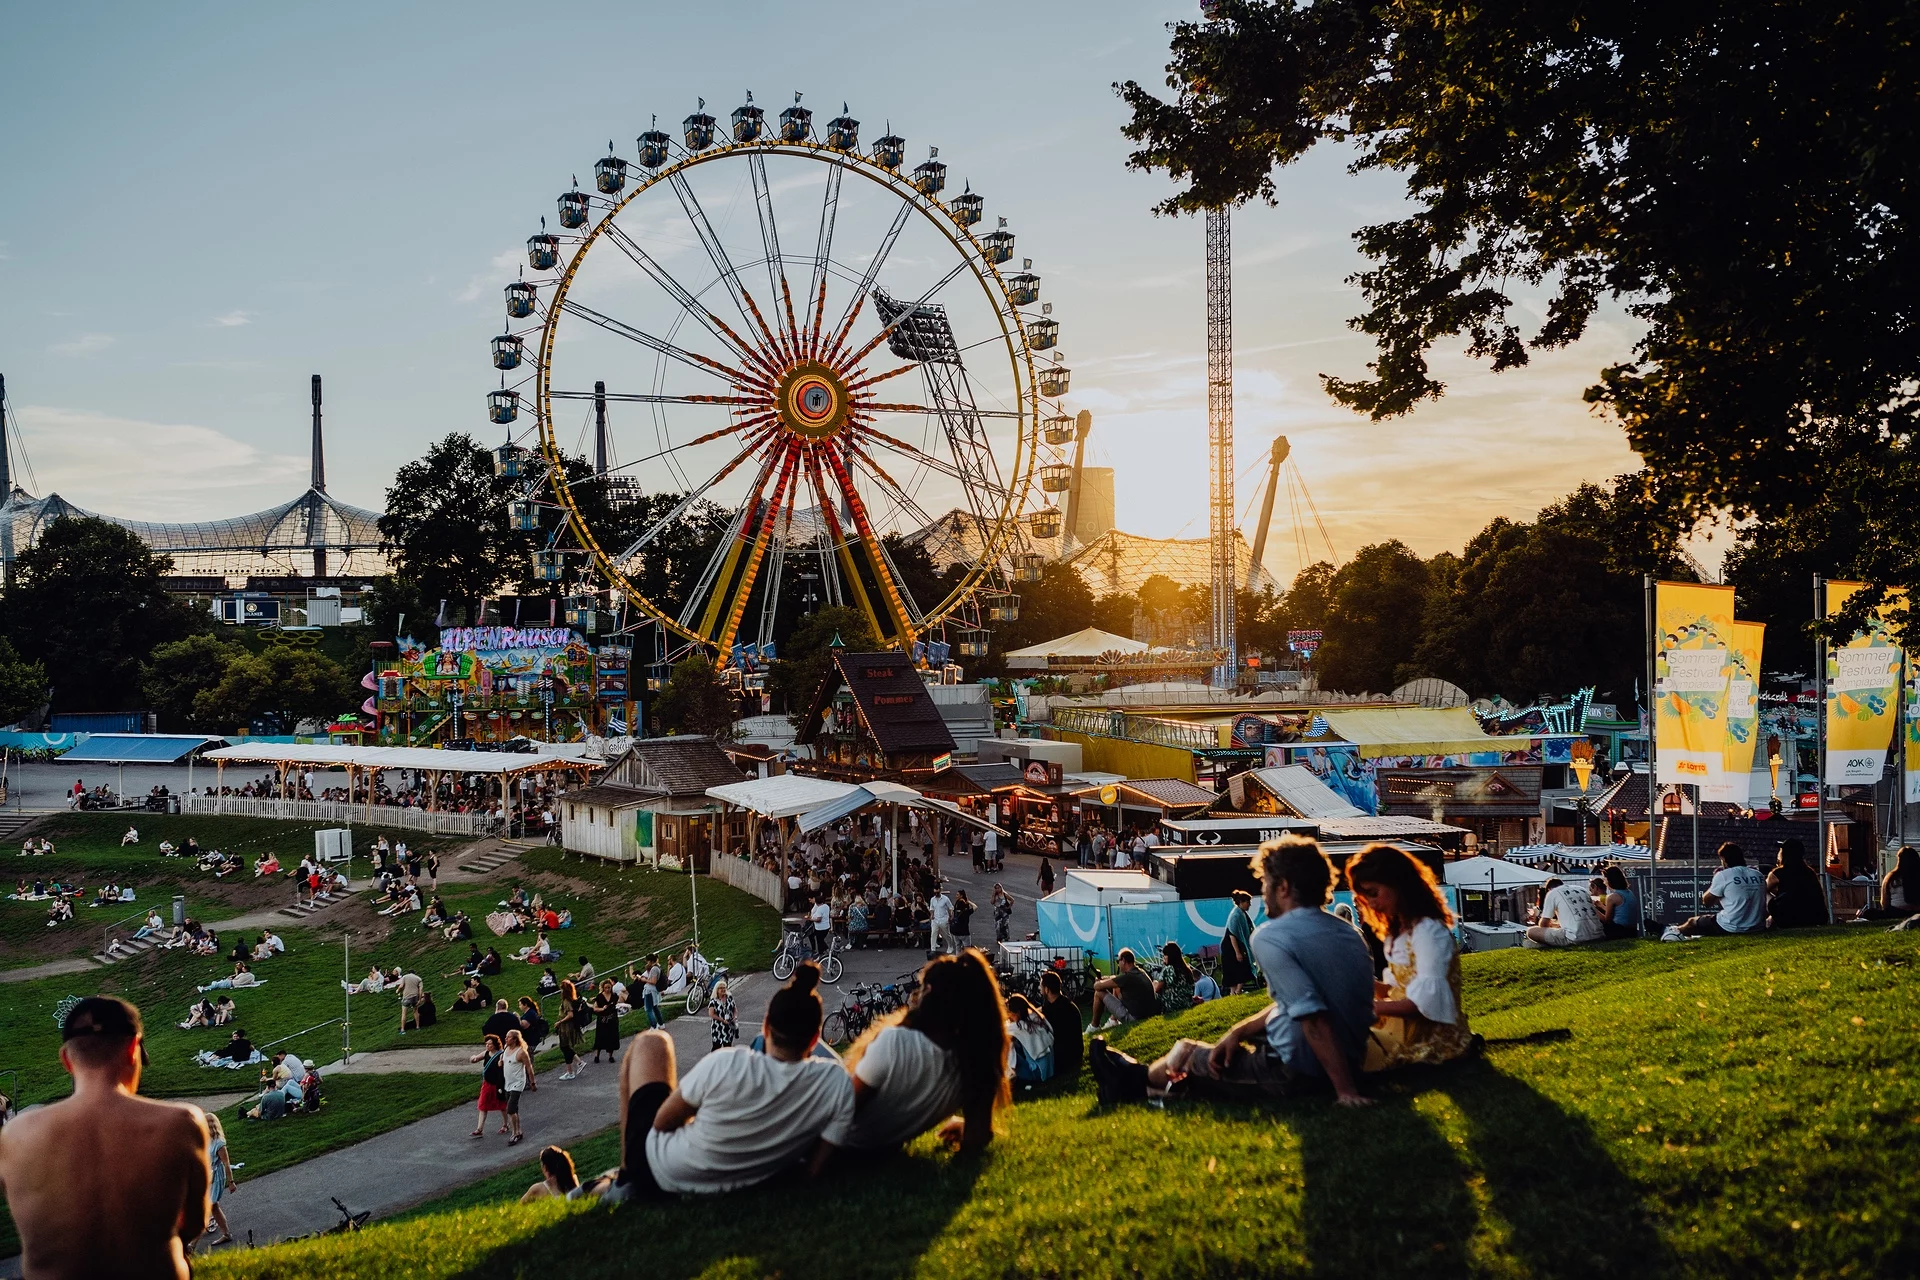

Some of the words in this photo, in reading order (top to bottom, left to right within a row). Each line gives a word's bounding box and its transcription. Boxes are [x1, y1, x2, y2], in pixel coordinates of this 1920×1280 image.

[440, 626, 571, 653] ALPENRAUSCH
[1669, 652, 1724, 664] Sommer
[1838, 651, 1893, 663] Sommer
[867, 668, 894, 678] Steak
[1672, 666, 1718, 678] Festival
[1841, 664, 1886, 677] Festival
[1665, 679, 1725, 691] Olympiapark
[1731, 684, 1750, 693] mer
[1835, 678, 1892, 690] Olympiapark
[873, 695, 913, 704] Pommes
[1729, 697, 1748, 706] ival
[1686, 763, 1706, 771] LOTTO
[1846, 759, 1865, 767] AOK
